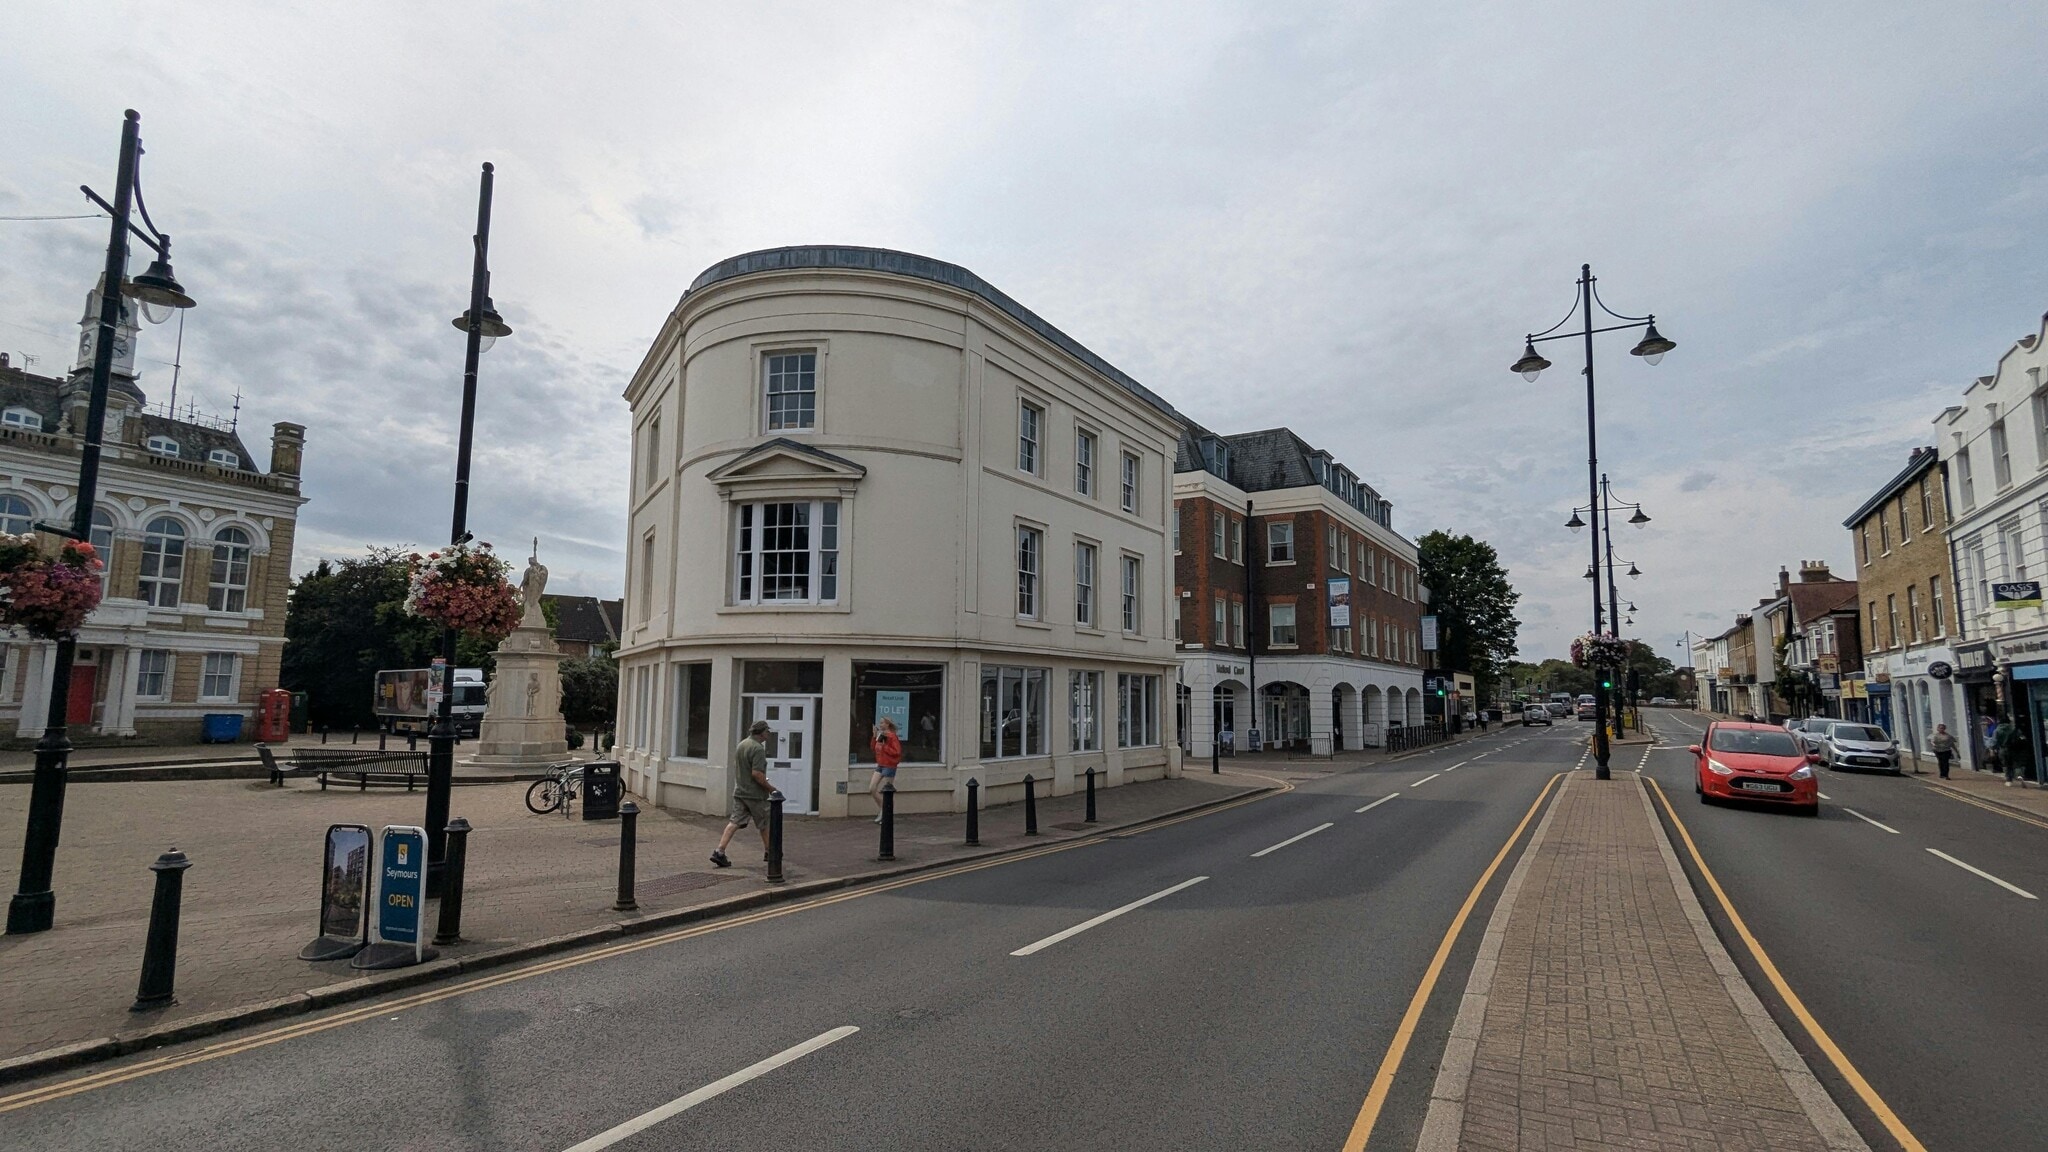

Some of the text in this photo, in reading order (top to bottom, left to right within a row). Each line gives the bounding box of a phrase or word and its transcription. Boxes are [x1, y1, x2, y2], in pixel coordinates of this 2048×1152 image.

[879, 705, 906, 715] TO LET
[386, 867, 418, 880] Seymours
[388, 894, 414, 908] OPEN
